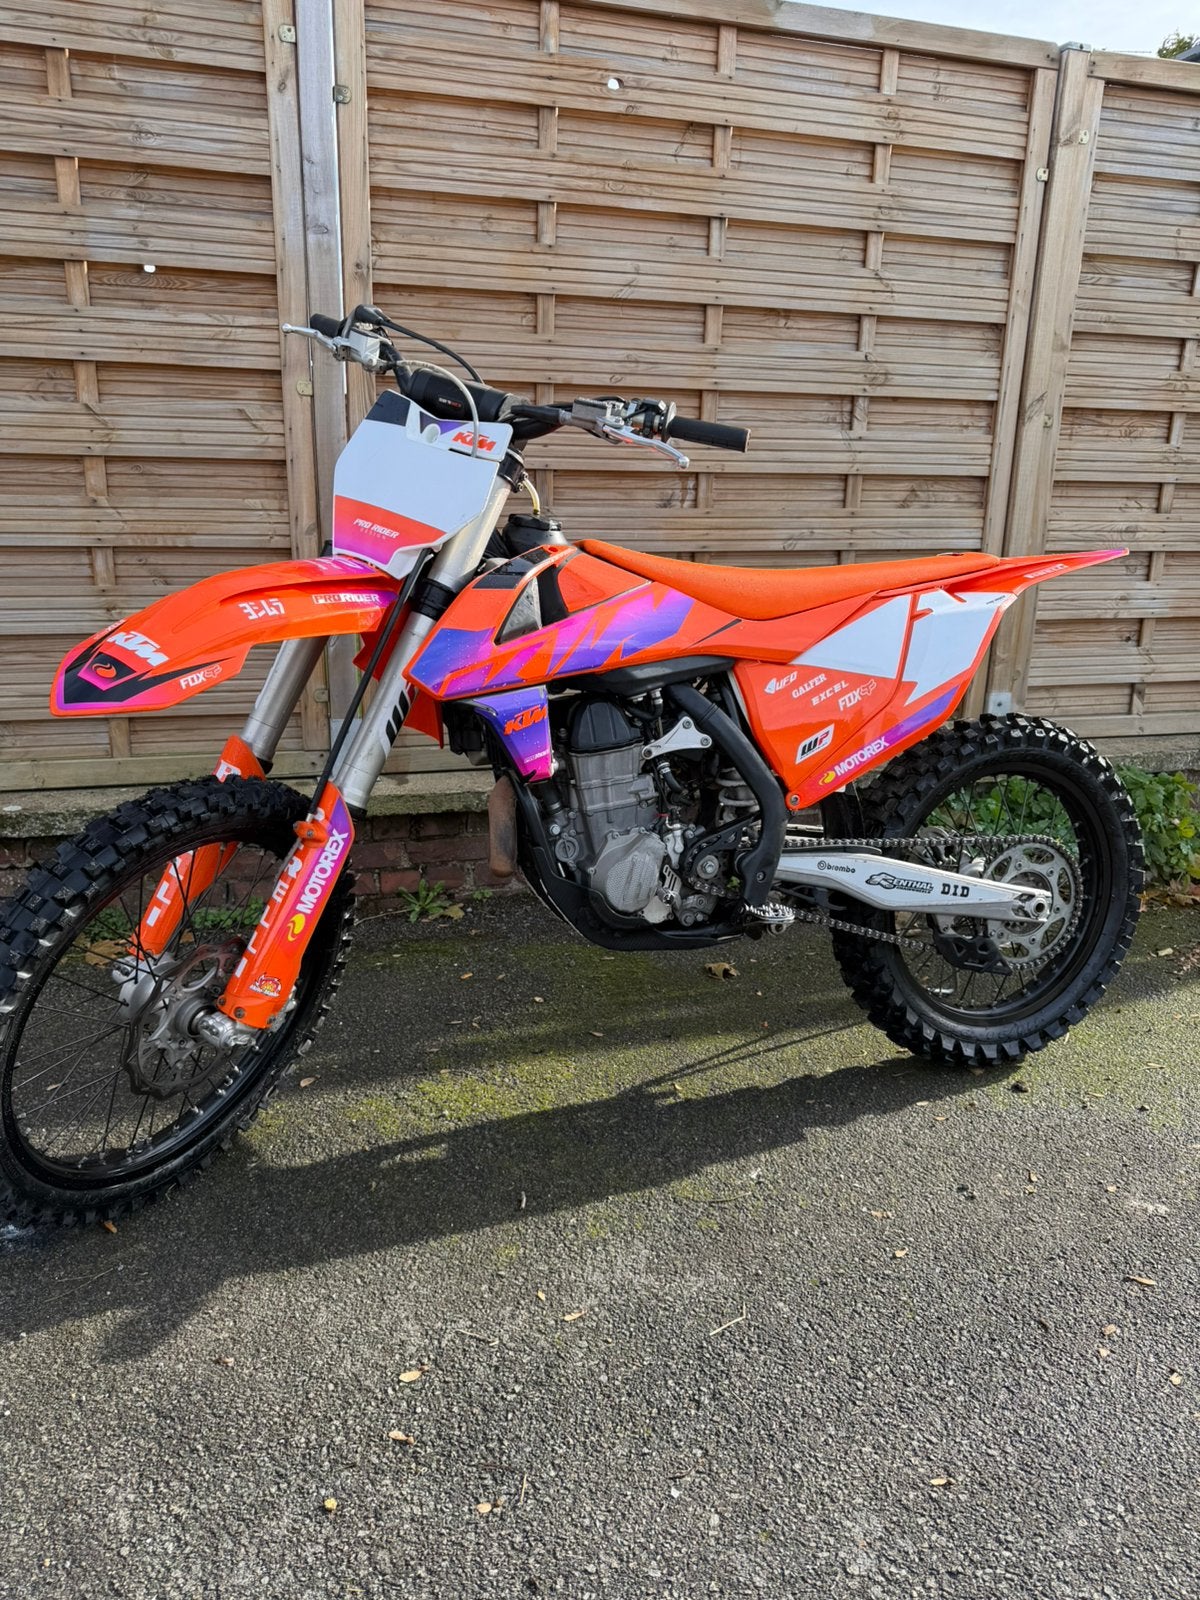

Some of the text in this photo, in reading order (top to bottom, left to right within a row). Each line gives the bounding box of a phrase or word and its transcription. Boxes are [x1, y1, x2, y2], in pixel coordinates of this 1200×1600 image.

[353, 518, 400, 539] PRO RIDER
[106, 631, 169, 667] KTM
[180, 671, 206, 690] FOX
[775, 671, 798, 692] UFO
[792, 673, 827, 698] GALFER
[811, 680, 849, 706] EXCEL
[838, 688, 862, 711] FOX
[503, 704, 548, 736] KTM
[834, 736, 890, 776] MOTOREX
[295, 828, 349, 915] MOTOREX
